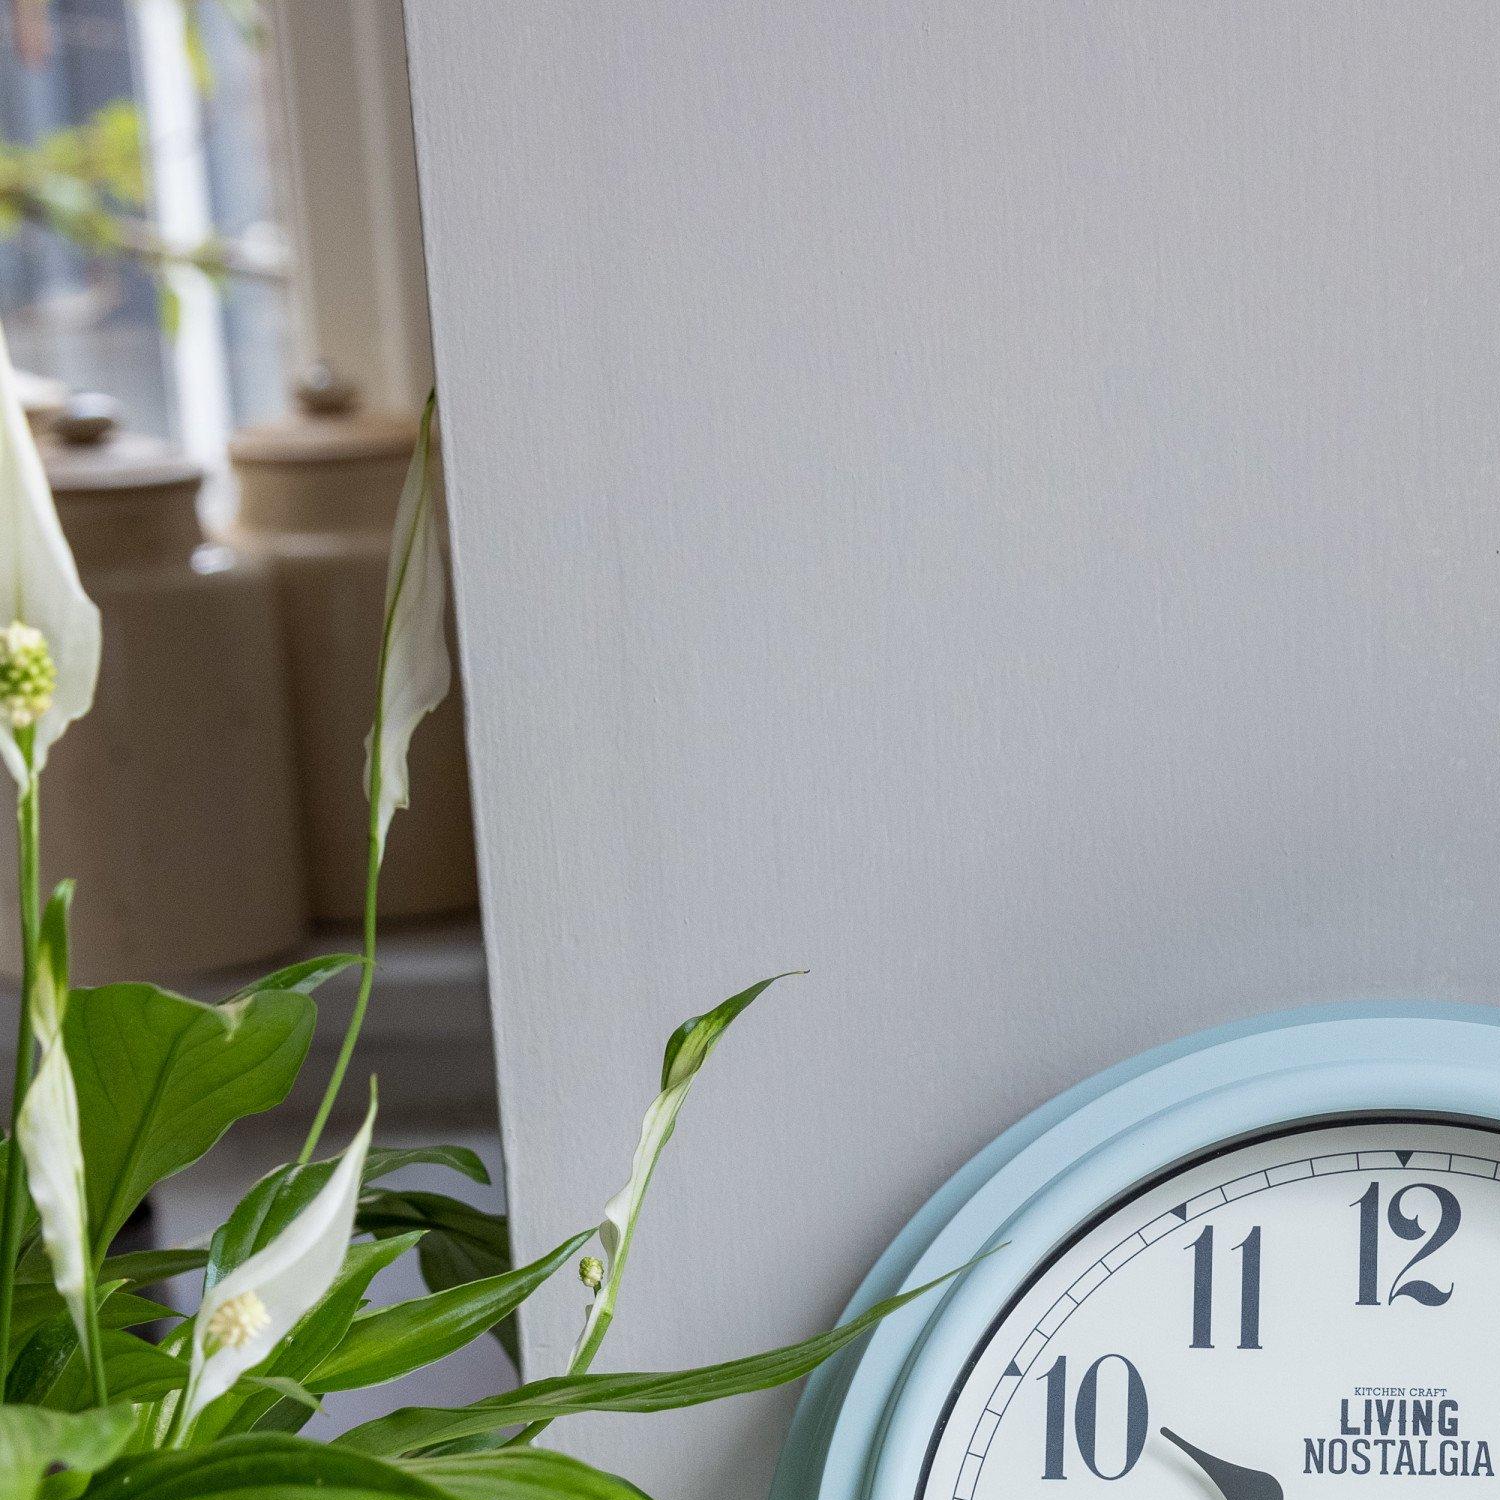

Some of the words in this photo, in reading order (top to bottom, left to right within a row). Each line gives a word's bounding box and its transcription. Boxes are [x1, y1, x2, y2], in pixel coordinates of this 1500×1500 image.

[1349, 1181, 1462, 1307] 12
[1184, 1225, 1264, 1350] 11
[1036, 1353, 1149, 1481] 10
[1340, 1398, 1459, 1437] LIVING
[1354, 1387, 1405, 1397] KITCHEN
[1409, 1388, 1448, 1398] CRAFT
[1303, 1438, 1495, 1477] NOSTALGIA
